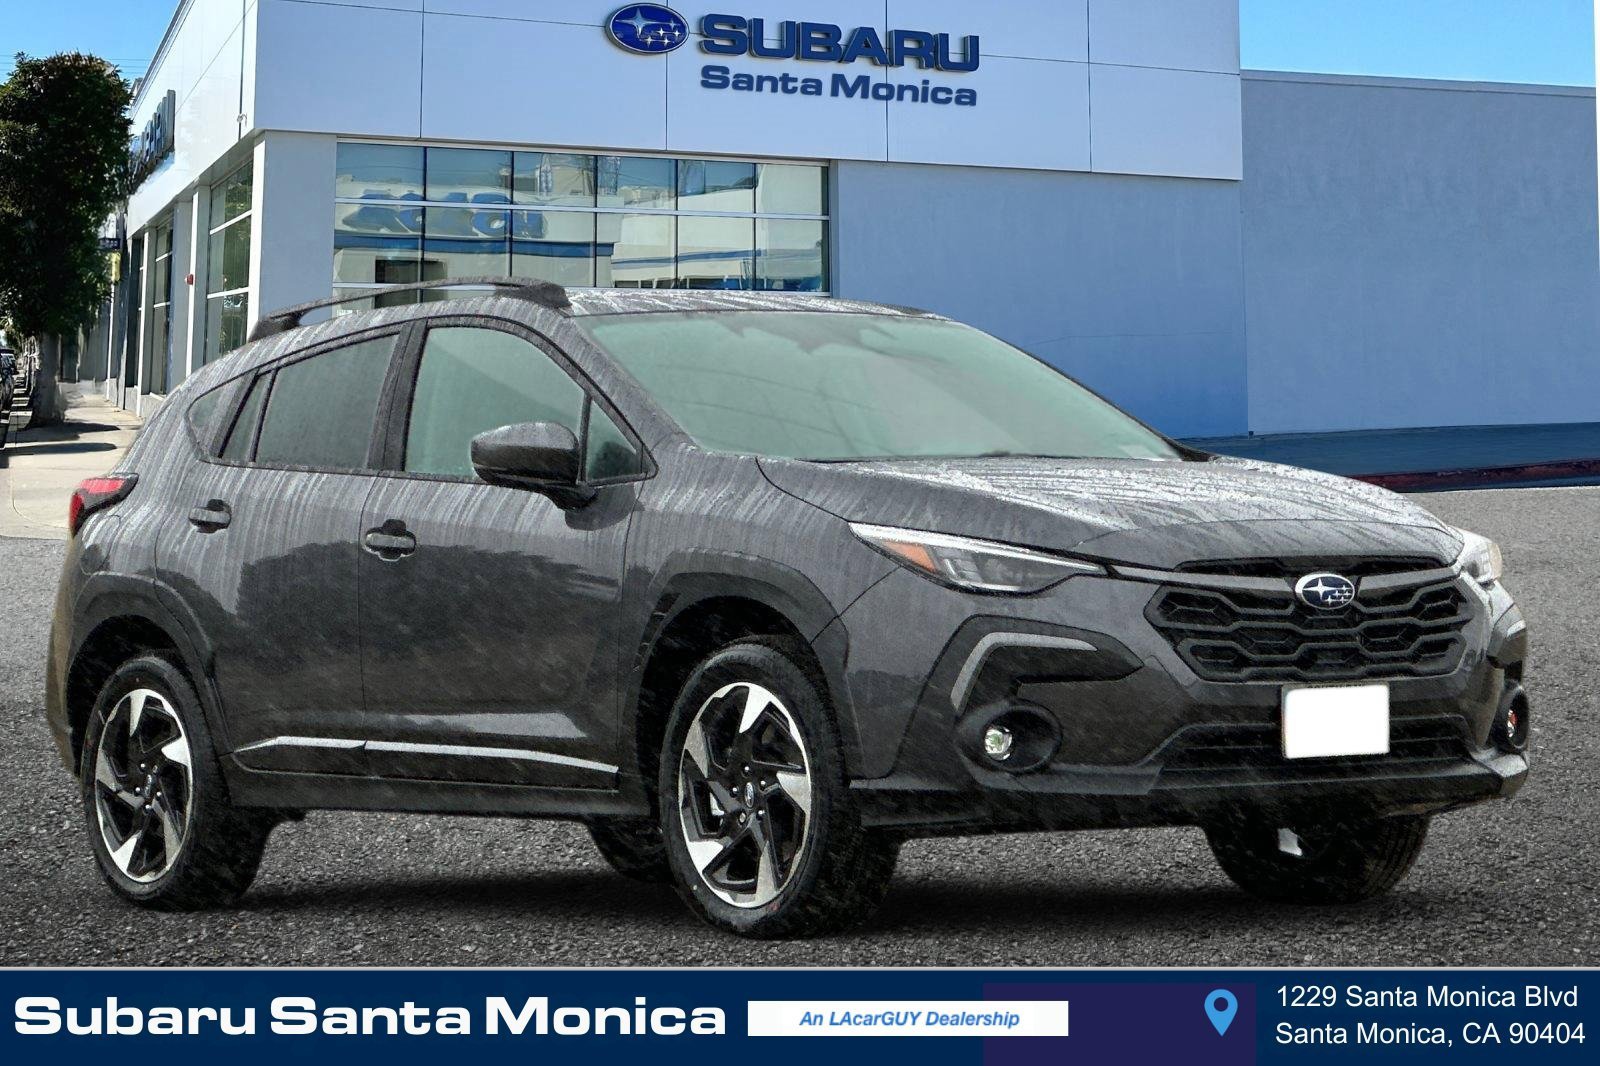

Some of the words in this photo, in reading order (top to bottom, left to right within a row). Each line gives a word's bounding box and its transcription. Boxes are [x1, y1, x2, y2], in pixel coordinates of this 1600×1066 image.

[699, 13, 980, 72] SUBARU
[700, 65, 823, 96] Santa
[830, 73, 978, 106] Monica
